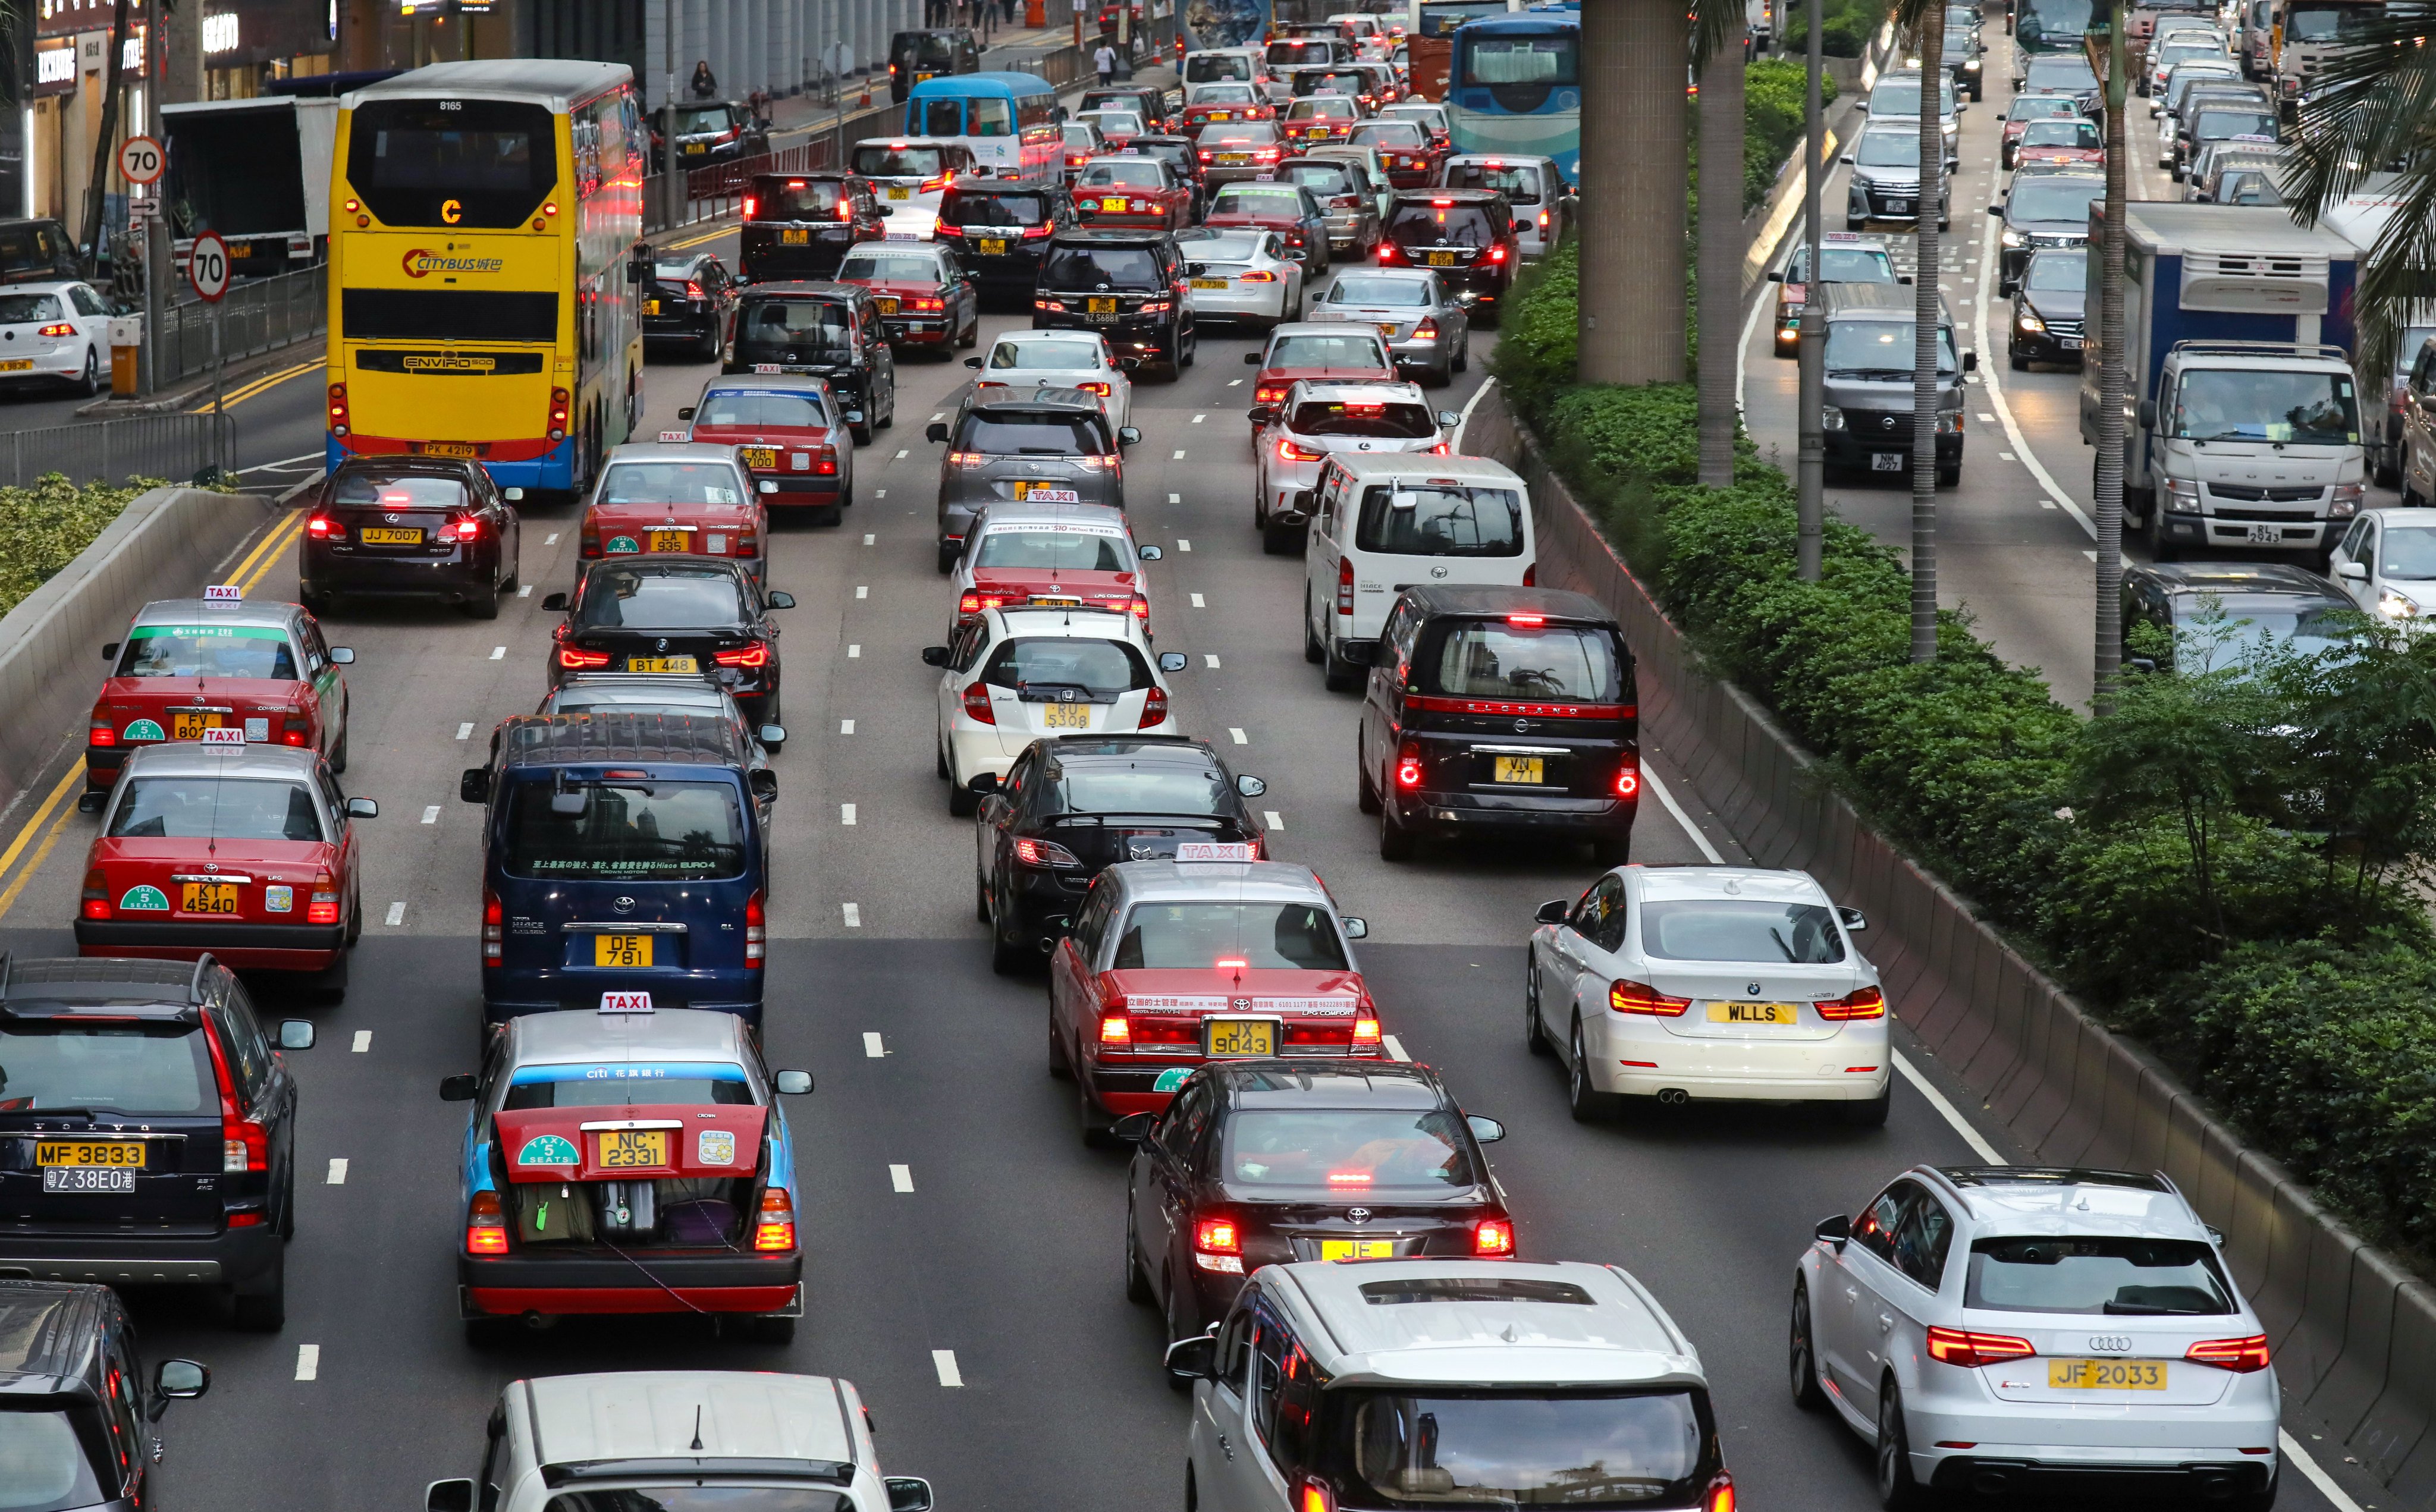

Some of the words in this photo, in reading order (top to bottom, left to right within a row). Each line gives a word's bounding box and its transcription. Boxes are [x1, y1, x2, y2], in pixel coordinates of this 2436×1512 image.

[440, 102, 462, 110] 8165
[128, 153, 156, 171] 70
[196, 254, 222, 282] 70
[417, 258, 475, 271] CITYBUS
[476, 258, 503, 271] 城巴
[8, 362, 27, 370] 9838
[428, 445, 441, 454] PK
[447, 447, 473, 455] 4219
[751, 449, 766, 458] KH
[748, 458, 771, 467] 7100
[1034, 491, 1073, 501] TAXI
[366, 530, 381, 540] JJ
[387, 530, 419, 540] 7007
[2258, 526, 2271, 534] RL
[663, 532, 677, 542] LA
[2250, 533, 2280, 542] 2943
[658, 542, 681, 551] 935
[209, 588, 236, 597] TAXI
[636, 660, 654, 671] BT
[661, 660, 688, 671] 448
[1058, 703, 1077, 715] RU
[1468, 704, 1577, 714] ELGRAND
[189, 715, 207, 726] FV
[1049, 715, 1087, 727] 5308
[207, 731, 240, 741] TAXI
[1510, 758, 1529, 770] VN
[1505, 770, 1533, 781] 471
[1183, 845, 1245, 858] TAXI
[199, 885, 221, 898] KT
[140, 894, 149, 902] 5
[186, 898, 234, 912] 4540
[611, 936, 637, 950] DE
[607, 951, 642, 964] 781
[606, 996, 647, 1009] TAXI
[1128, 998, 1178, 1007] 立圖的士管理
[1729, 1005, 1776, 1021] WLLS
[1229, 1023, 1254, 1038] JX
[1215, 1038, 1267, 1053] 9043
[587, 1068, 607, 1078] citi
[616, 1068, 665, 1077] 花旗銀行
[1176, 1076, 1185, 1084] 4
[529, 1136, 565, 1148] TAXI
[619, 1132, 646, 1149] NC
[41, 1146, 71, 1164] MF
[79, 1146, 140, 1164] 3833
[544, 1144, 554, 1156] 5
[608, 1148, 658, 1165] 2331
[1342, 1242, 1372, 1258] JE
[2058, 1365, 2086, 1384] JF
[2096, 1365, 2158, 1385] 2033
